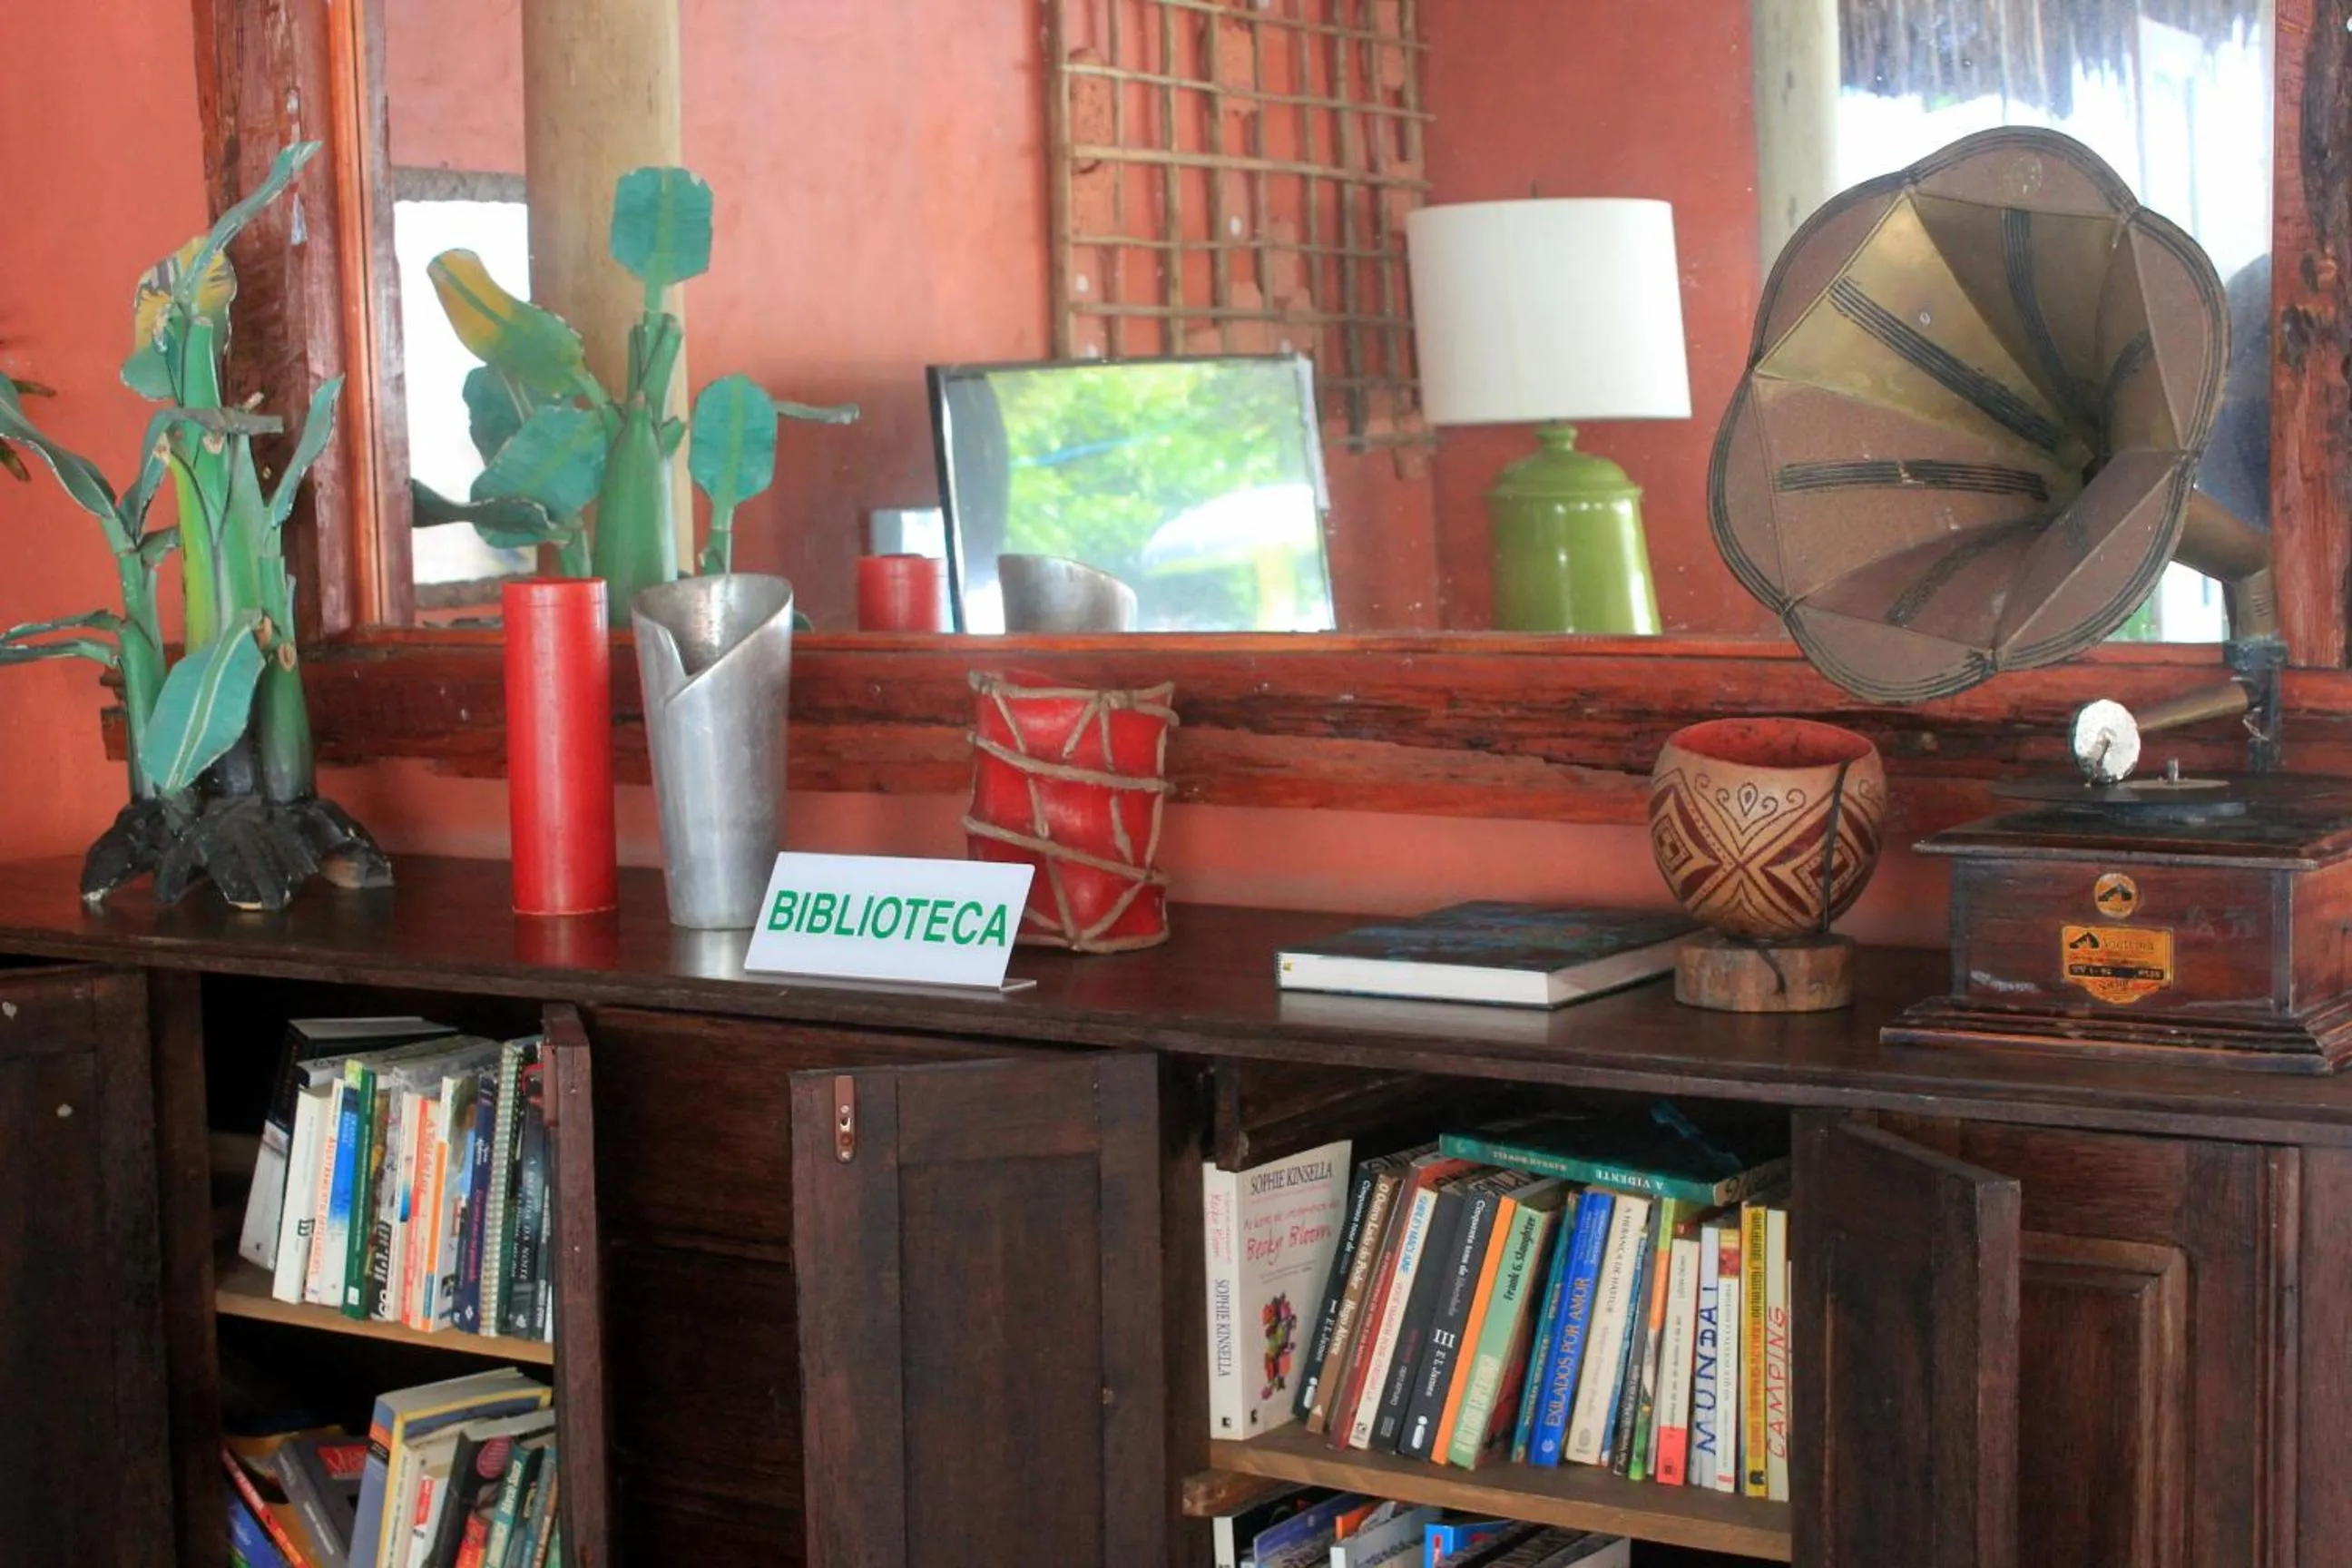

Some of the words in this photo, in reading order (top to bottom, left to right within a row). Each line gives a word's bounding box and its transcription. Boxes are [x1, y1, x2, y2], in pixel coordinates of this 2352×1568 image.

[768, 889, 1008, 946] BIBLIOTECA
[1250, 1171, 1286, 1195] SOPHIE
[1287, 1161, 1333, 1187] KINSELLA
[1457, 1264, 1468, 1276] de
[1504, 1273, 1520, 1301] Frank
[1215, 1279, 1230, 1320] SOPHIE
[1567, 1277, 1590, 1320] AMOR
[1216, 1321, 1231, 1377] KINSELLA
[1561, 1323, 1582, 1353] POR
[1425, 1366, 1442, 1397] James
[1544, 1357, 1571, 1427] EXILADOS
[1766, 1306, 1787, 1460] CAMPING
